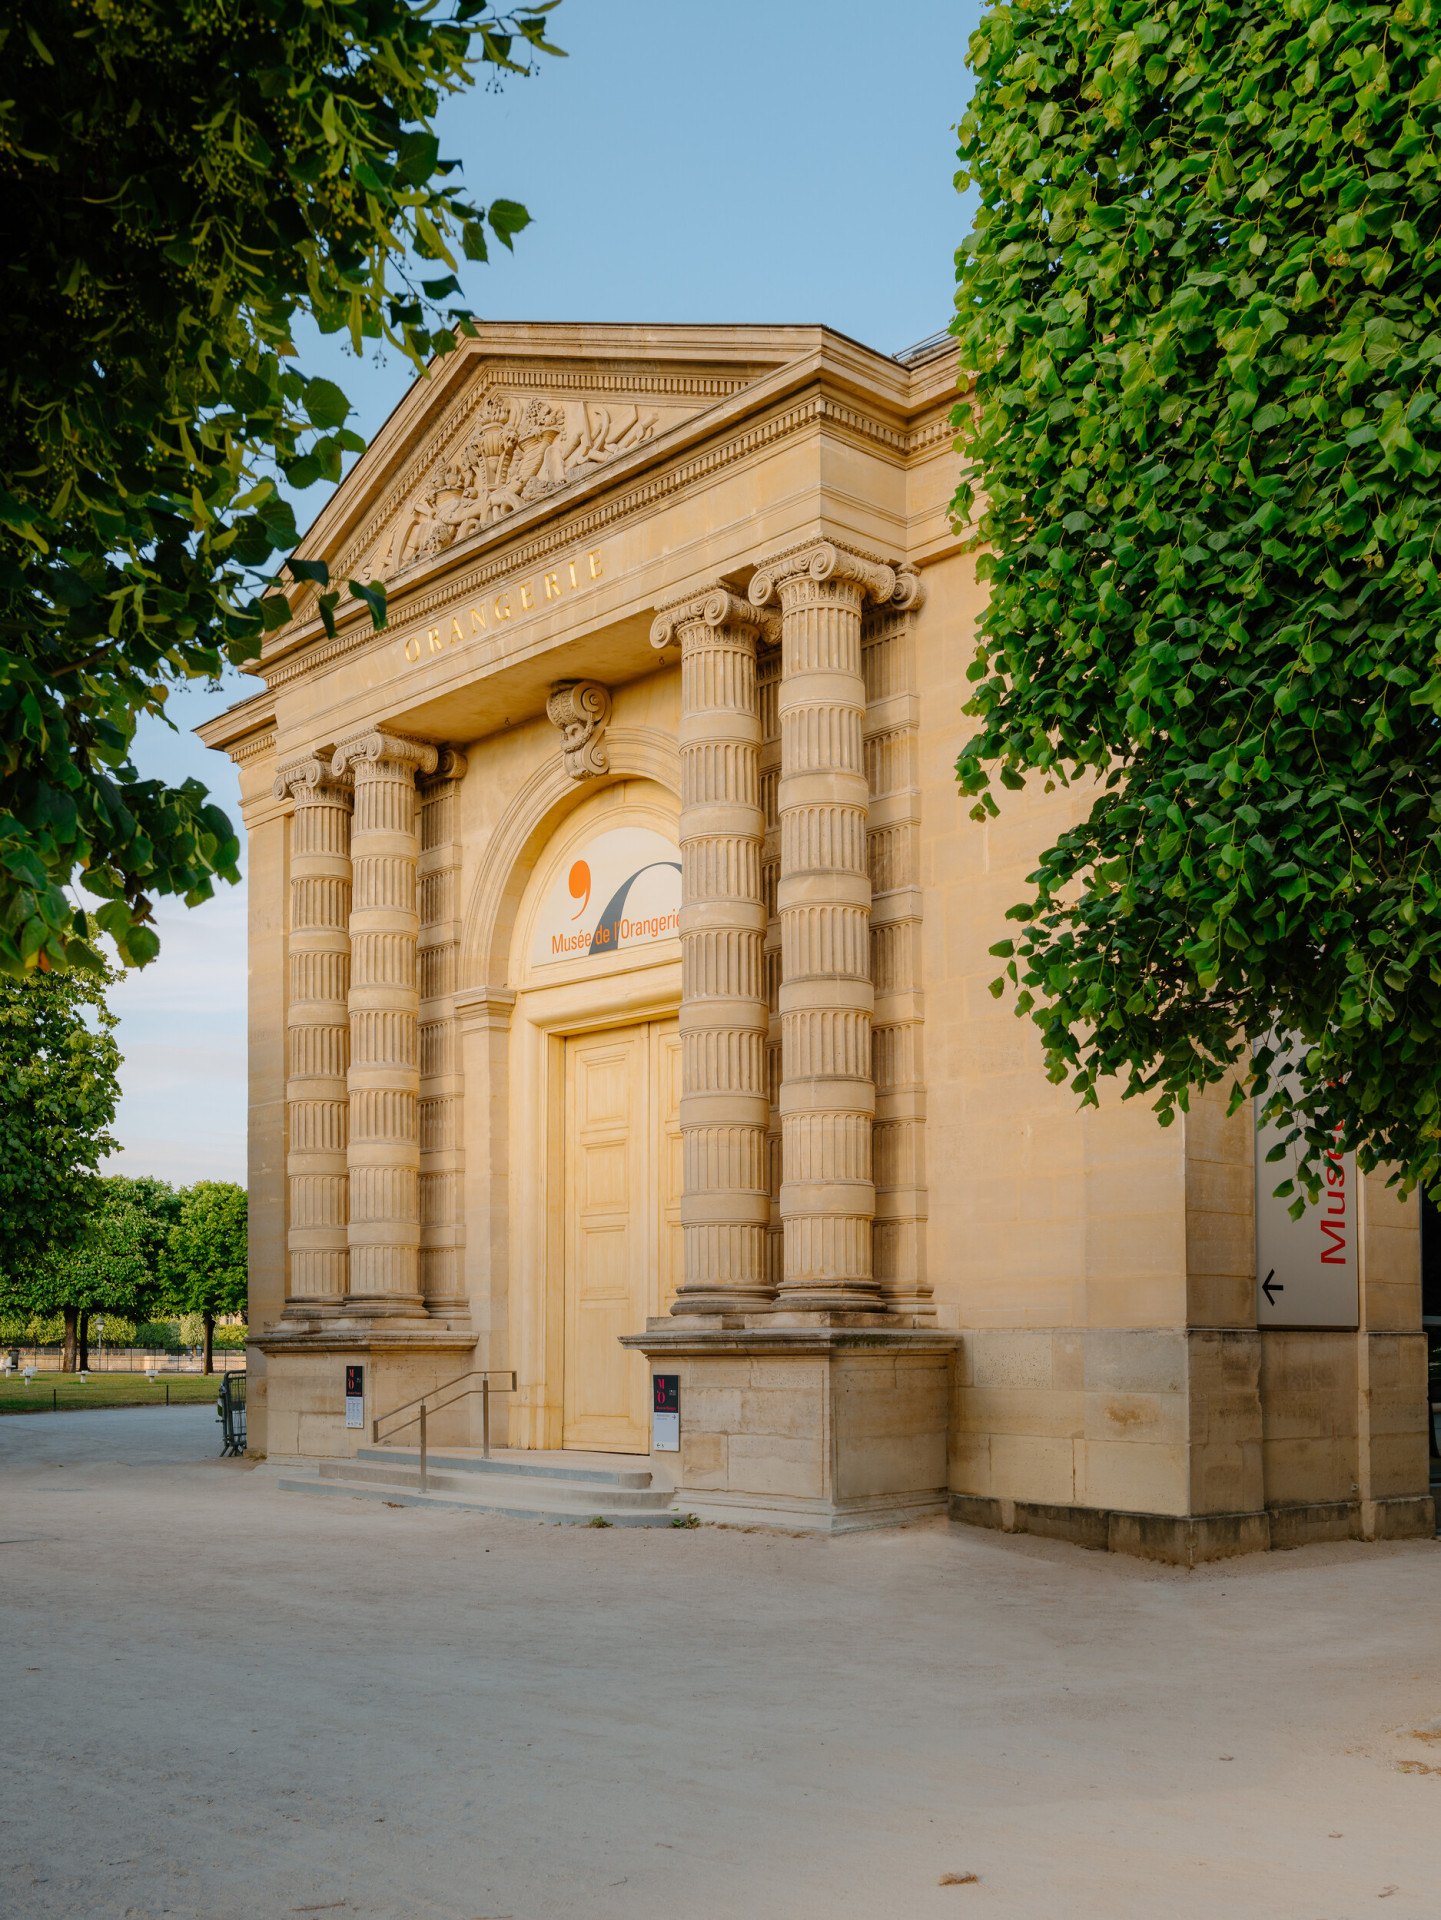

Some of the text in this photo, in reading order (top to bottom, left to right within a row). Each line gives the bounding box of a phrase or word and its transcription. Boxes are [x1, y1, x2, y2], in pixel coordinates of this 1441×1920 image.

[405, 549, 603, 663] ORANGERIE
[552, 929, 592, 954] Musée
[595, 924, 610, 945] de
